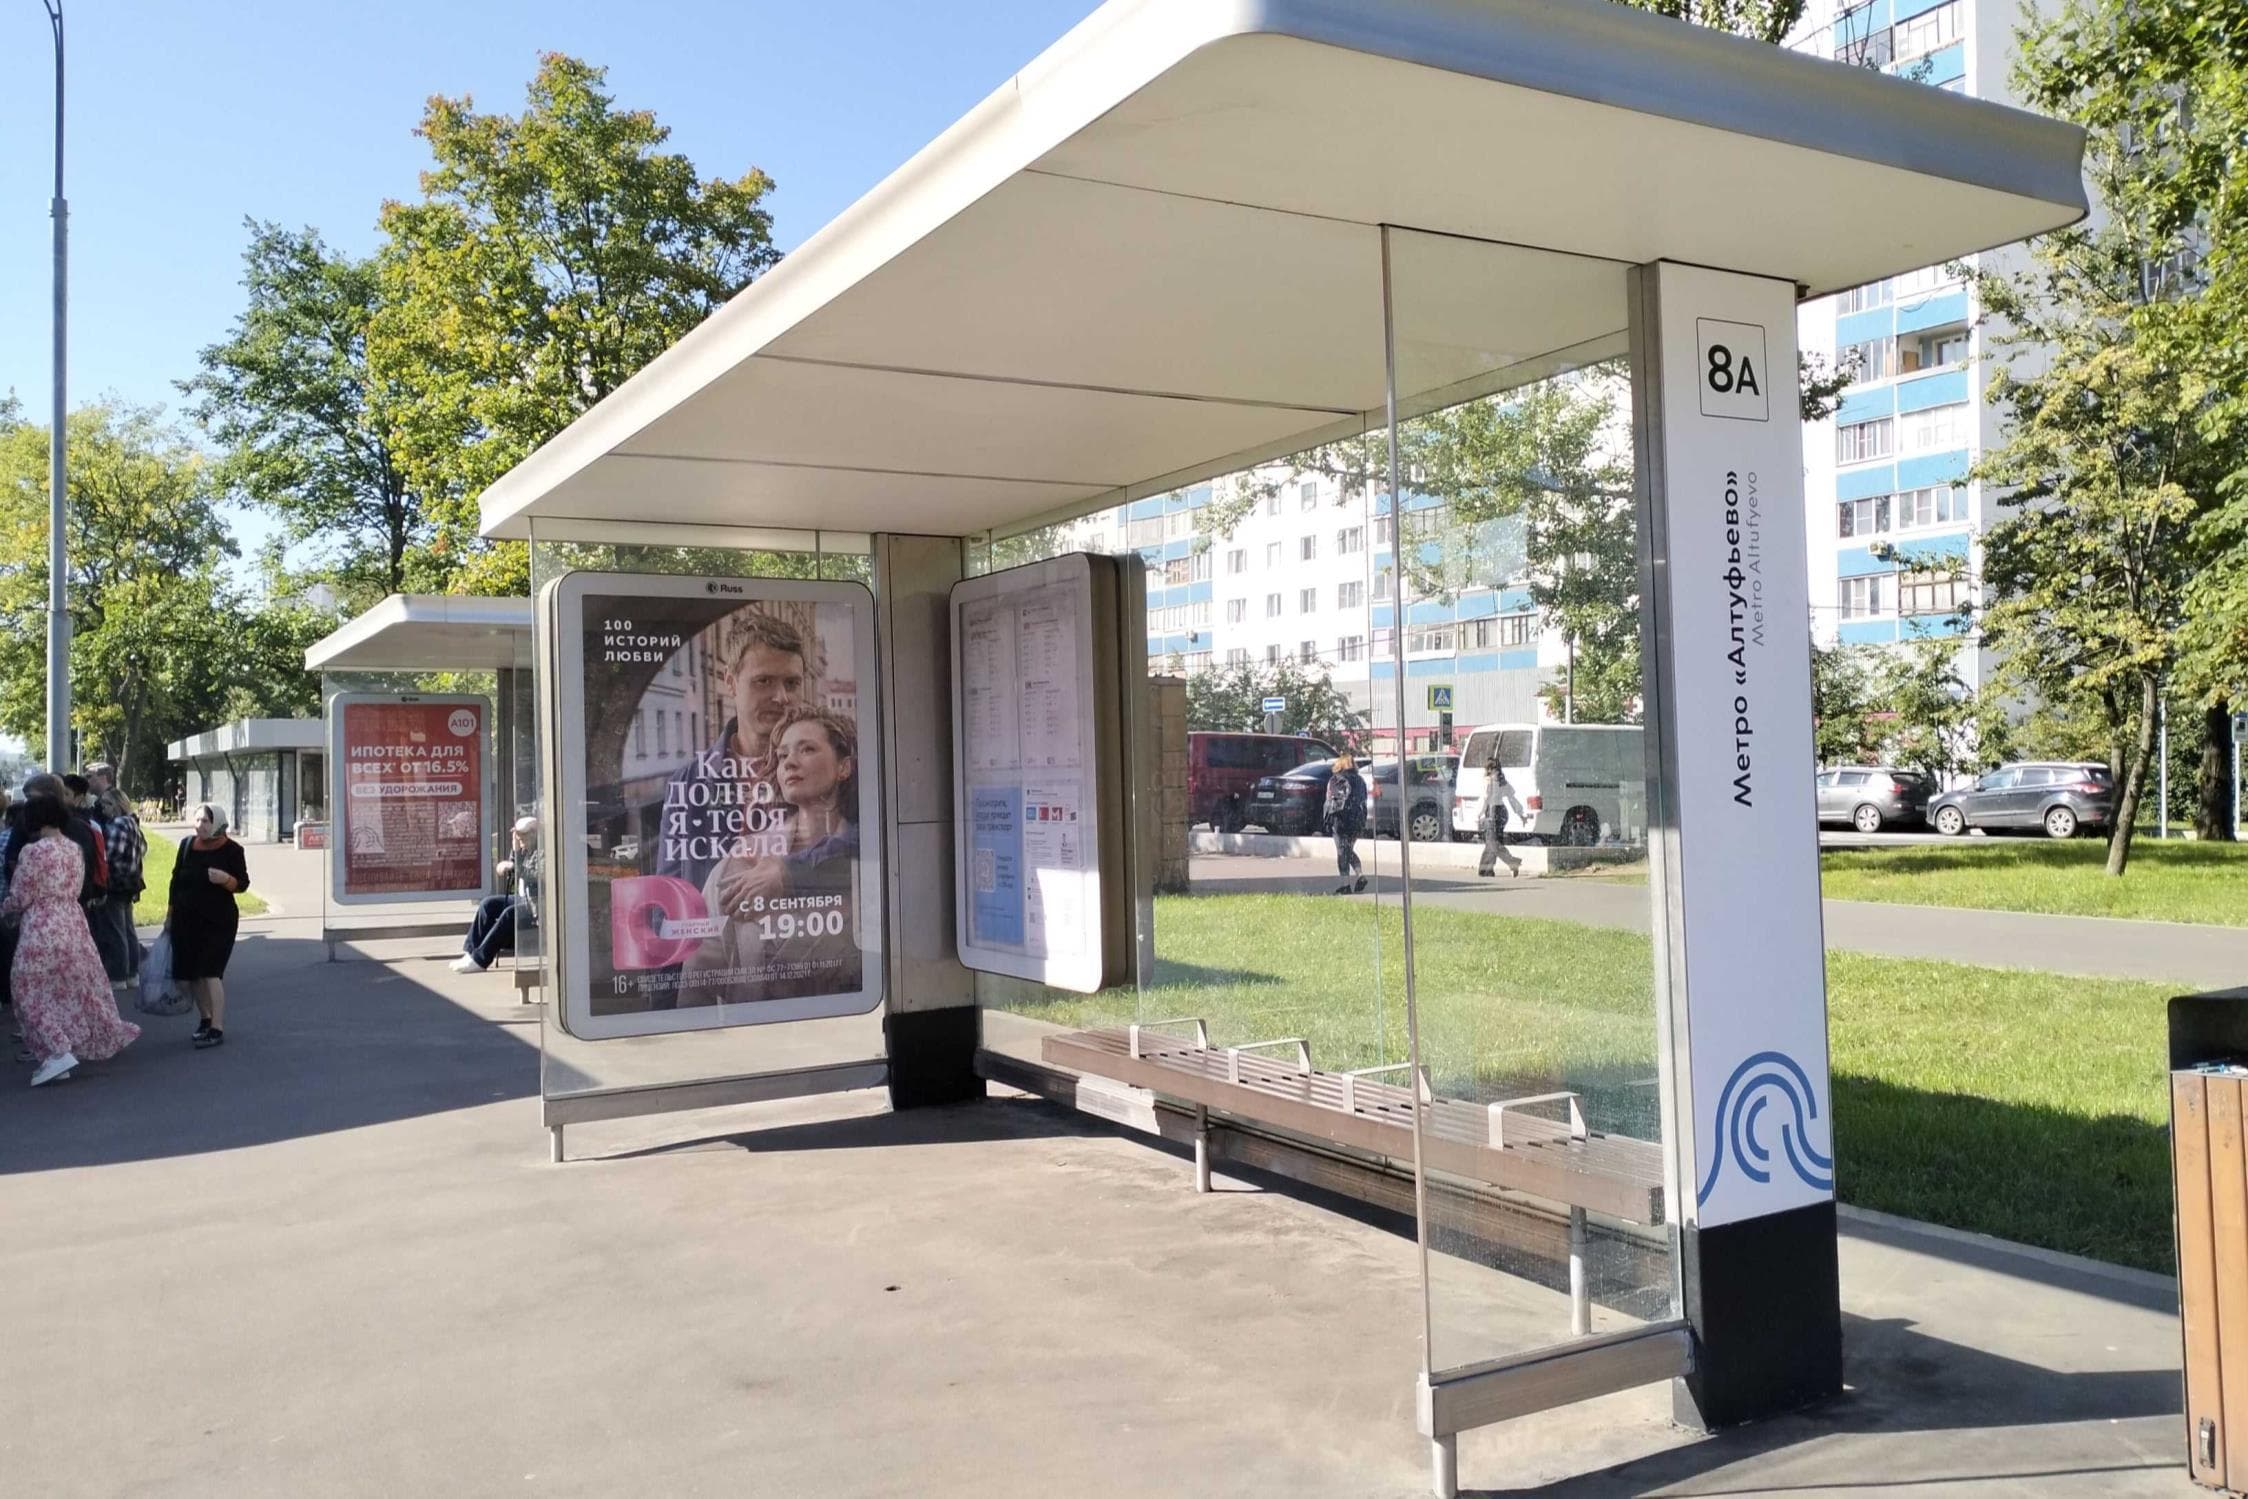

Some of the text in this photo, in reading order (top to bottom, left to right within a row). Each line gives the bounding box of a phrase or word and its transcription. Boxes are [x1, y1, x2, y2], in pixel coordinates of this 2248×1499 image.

[1707, 344, 1760, 396] 8А
[1746, 471, 1765, 646] Metro Altufyevo
[720, 584, 743, 593] Russ
[604, 620, 632, 631] 100
[604, 635, 681, 647] ИСТОРИЙ
[1722, 471, 1753, 808] Метро «Алтуфьево»
[604, 651, 664, 662] ЛЮБВИ
[351, 746, 464, 758] ИПОТЕКА ДЛЯ
[400, 762, 422, 773] ОТ
[423, 760, 469, 773] 16.5%
[695, 751, 760, 779] Как
[663, 781, 774, 810] долго
[668, 801, 788, 835] я тебя
[664, 832, 789, 861] искала
[753, 896, 765, 912] 8
[769, 895, 843, 910] СЕНТЯБРЯ
[758, 910, 844, 940] 19:00
[612, 975, 634, 995] 16+
